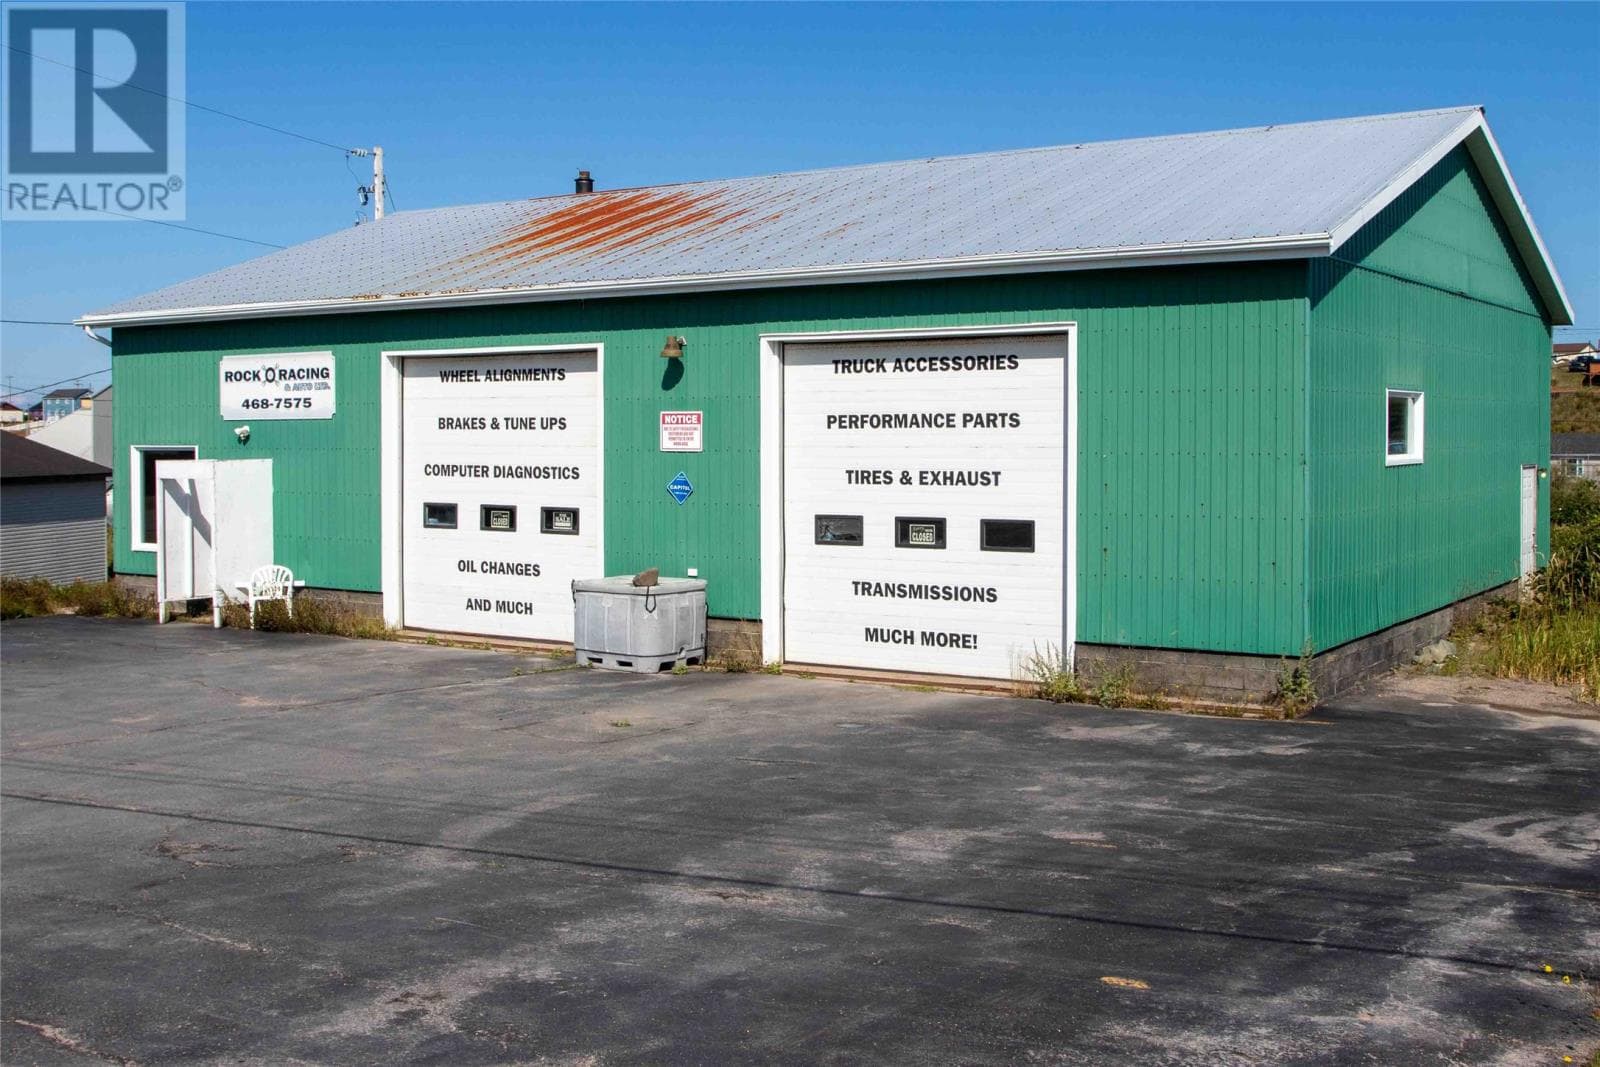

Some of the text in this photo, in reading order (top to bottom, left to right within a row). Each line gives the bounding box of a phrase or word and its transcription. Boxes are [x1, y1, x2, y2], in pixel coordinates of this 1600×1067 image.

[832, 354, 1019, 374] TRUCK ACCESSORIES
[224, 370, 261, 383] ROCK
[278, 367, 330, 381] RACING
[440, 368, 566, 383] WHEEL ALIGNMENTS
[292, 382, 313, 391] AUTO
[241, 397, 312, 410] 468-7575
[438, 417, 567, 430] BRAKES & TUNE UPS
[664, 414, 698, 424] NOTICE
[826, 412, 1021, 429] PERFORMANCE PARTS
[424, 463, 580, 480] COMPUTER DIAGNOSTICS
[845, 469, 1001, 486] TIRES & EXHAUST
[912, 532, 934, 541] CLOSED
[457, 559, 541, 577] OIL CHANGES
[852, 580, 998, 603] TRANSMISSIONS
[465, 598, 533, 615] AND MUCH
[864, 627, 978, 650] MUCH MORE!
